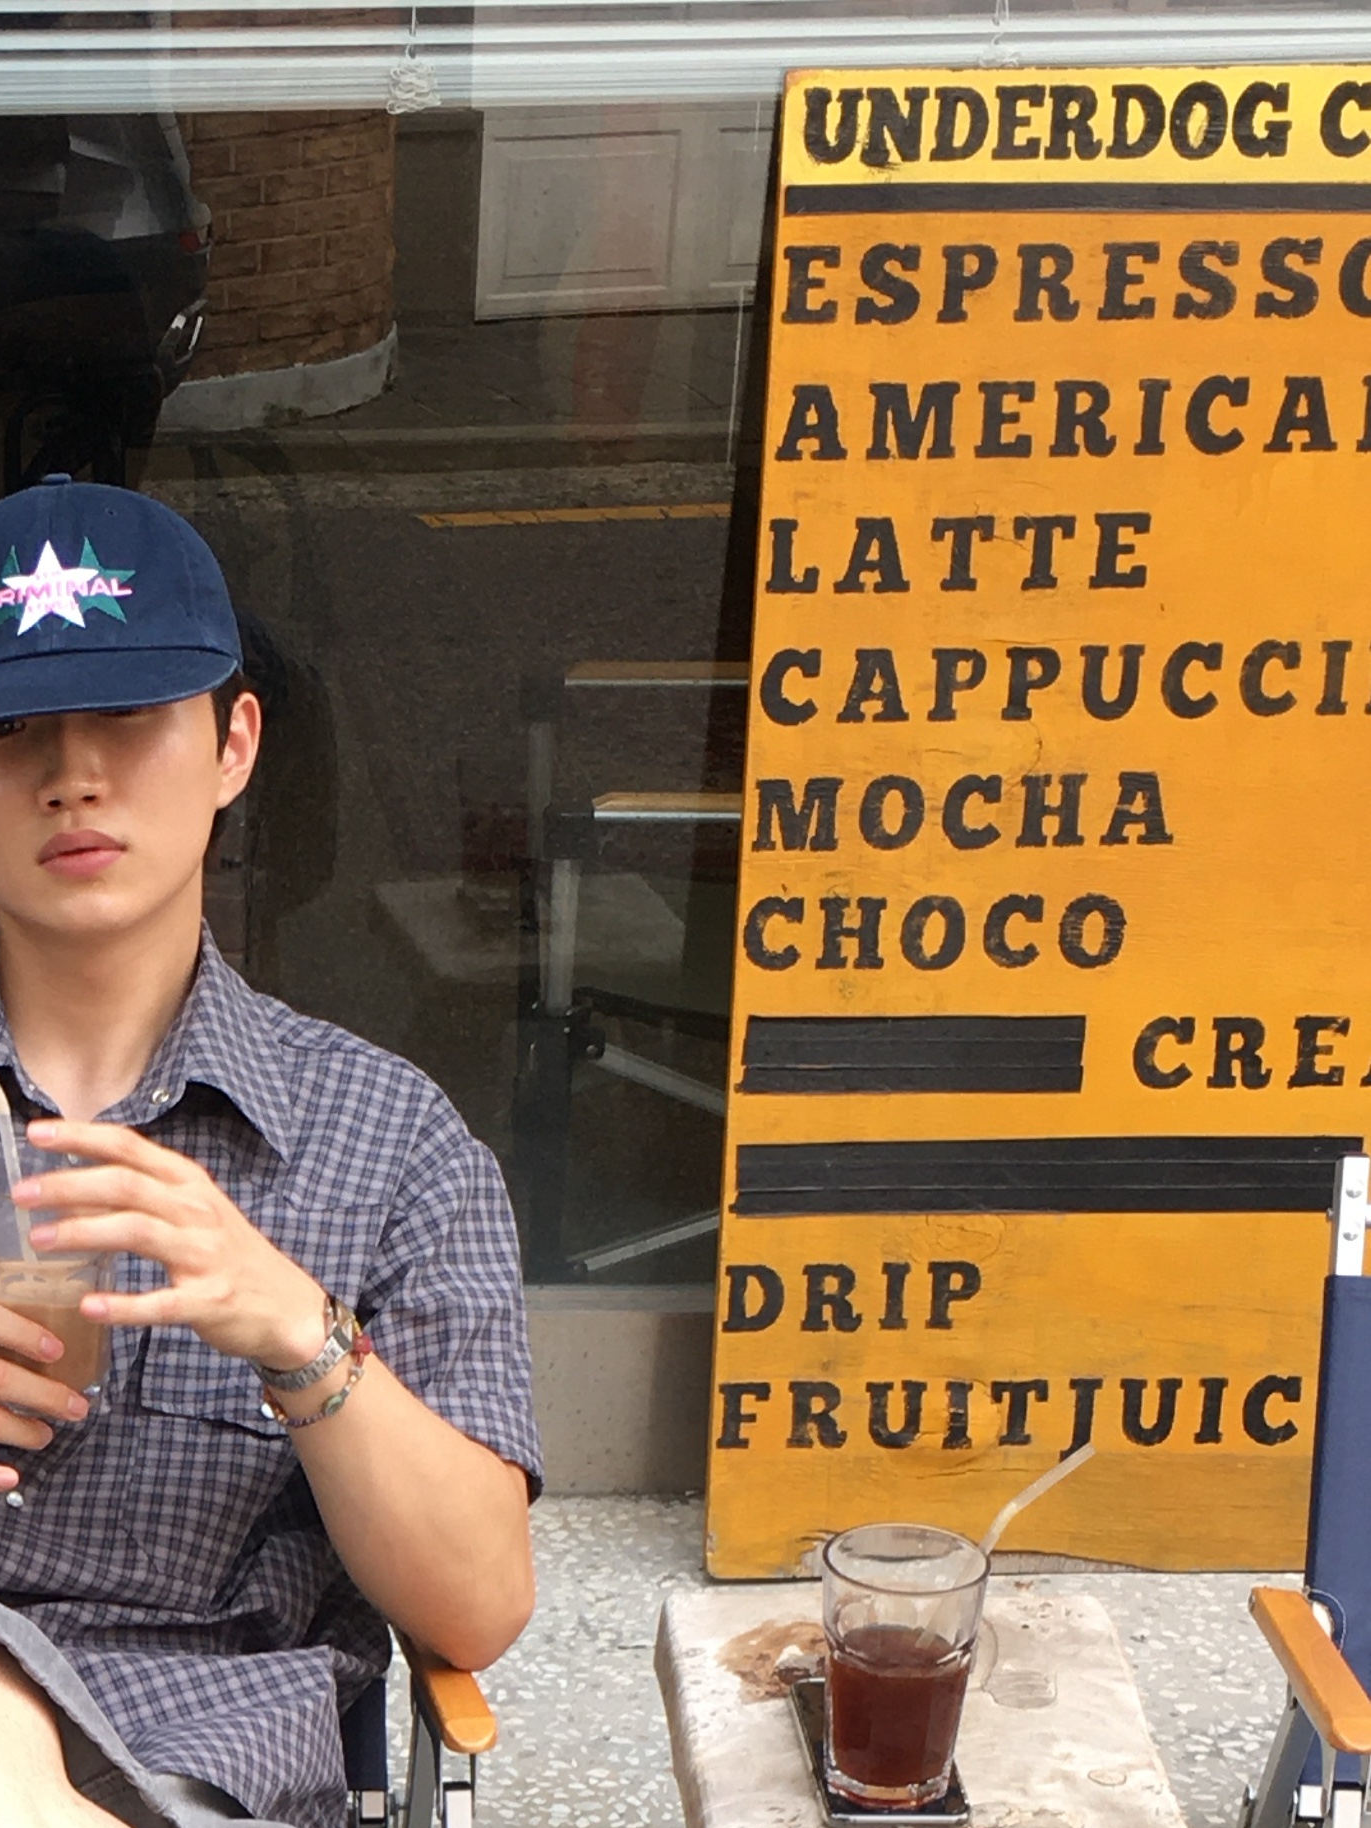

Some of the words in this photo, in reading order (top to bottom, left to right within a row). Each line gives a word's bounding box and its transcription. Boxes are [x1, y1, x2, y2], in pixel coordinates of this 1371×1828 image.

[803, 80, 1292, 169] UNDERDOG
[1319, 80, 1371, 158] C
[774, 374, 1371, 462] AMERICA
[764, 511, 1152, 595] LATTE
[758, 638, 1371, 727] CAPPUCCI
[750, 770, 1175, 853] MOCHA
[742, 892, 1128, 971] CHOCO
[1132, 1014, 1371, 1090] CRE
[721, 1259, 983, 1334] DRIP
